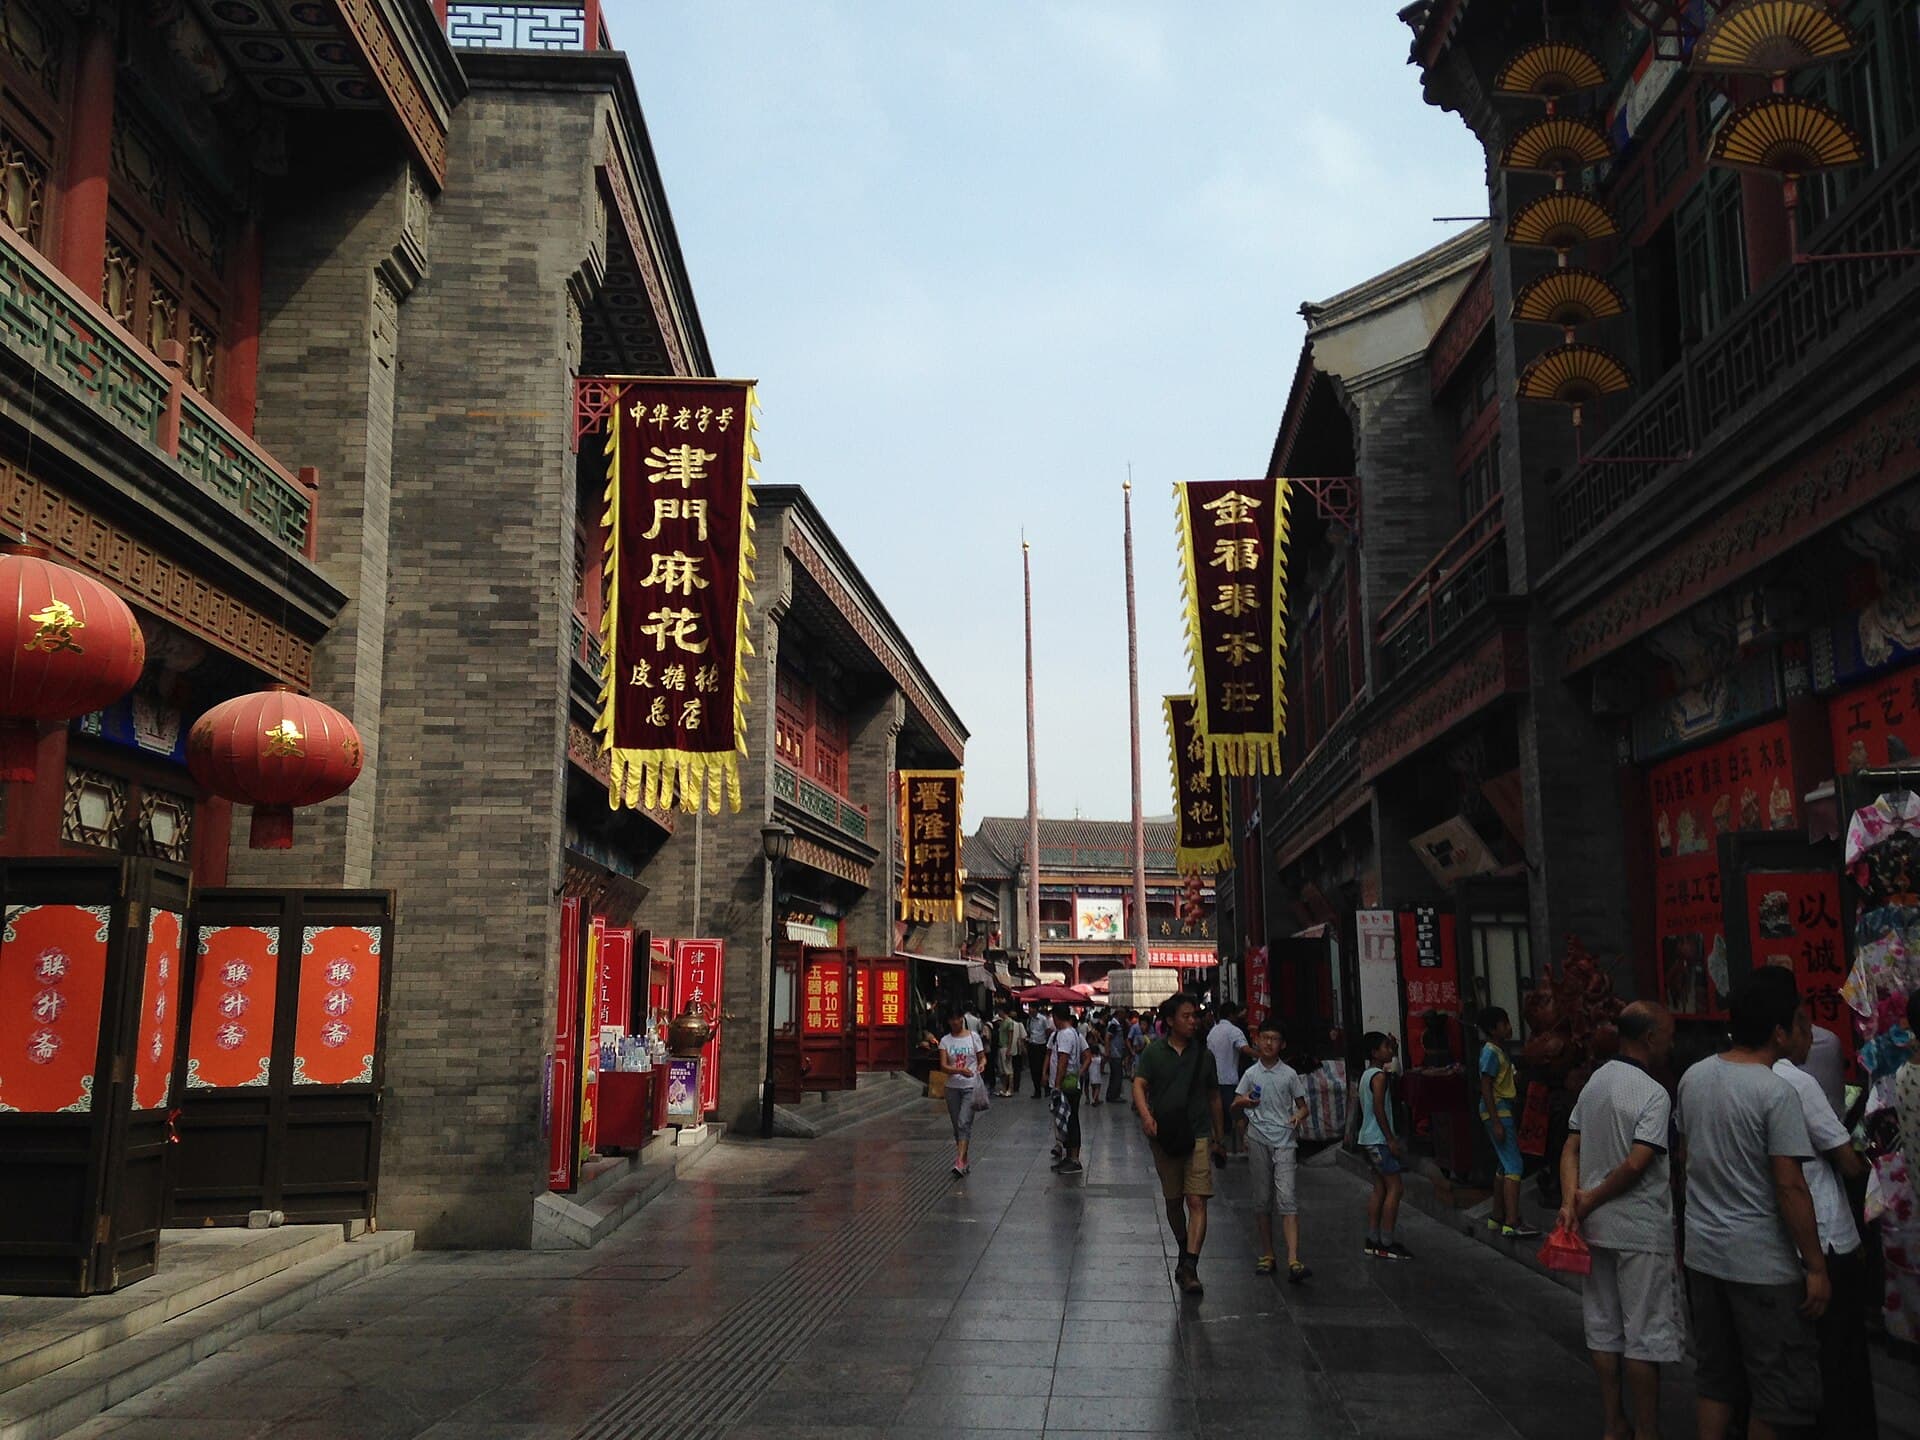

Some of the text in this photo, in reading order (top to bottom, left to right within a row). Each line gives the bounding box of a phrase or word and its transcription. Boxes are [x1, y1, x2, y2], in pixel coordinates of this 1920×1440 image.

[629, 400, 734, 432] 中华老字号
[640, 443, 717, 654] 津門麻花
[645, 695, 701, 729] 总店
[33, 953, 66, 1059] 联升斋
[221, 963, 249, 1046] 联升斋
[325, 963, 352, 1043] 联升斋
[690, 949, 705, 1014] 津门老
[807, 965, 822, 1028] 玉器直销
[824, 970, 839, 1028] 一律10元
[882, 970, 898, 1024] 翡翠和田玉
